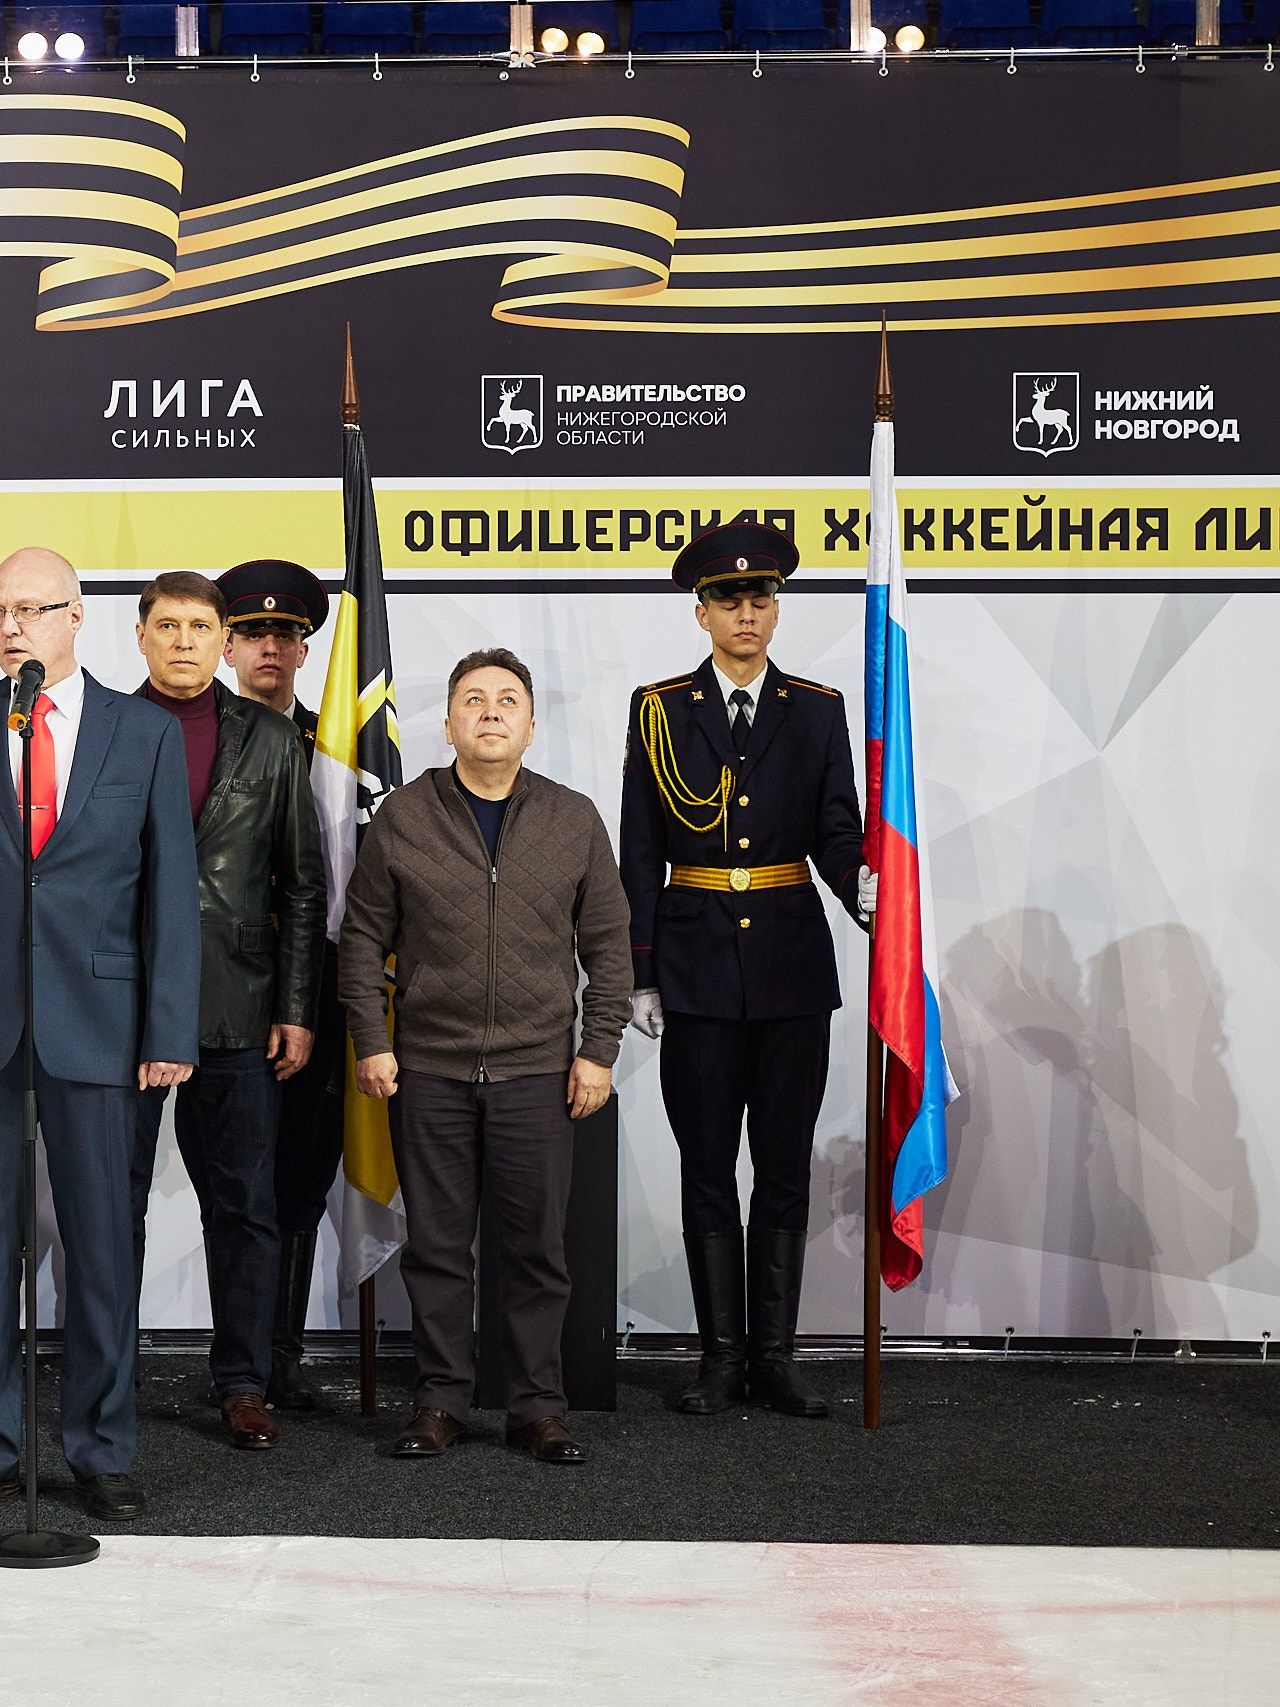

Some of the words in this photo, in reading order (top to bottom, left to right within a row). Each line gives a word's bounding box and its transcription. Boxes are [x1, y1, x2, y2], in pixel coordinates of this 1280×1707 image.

[103, 378, 264, 418] ЛИГА
[556, 384, 746, 402] ПРАВИТЕЛЬСТВО
[1094, 384, 1214, 411] НИЖНИЙ
[557, 408, 727, 428] НИЖЕГОРОДСКОЙ
[111, 429, 256, 448] СИЛЬНЫХ
[556, 430, 645, 445] ОБЛАСТИ
[1094, 419, 1240, 442] НОВГОРОД
[824, 494, 1169, 551] ХККЕЙНАЯ
[1195, 507, 1280, 551] ЛИ
